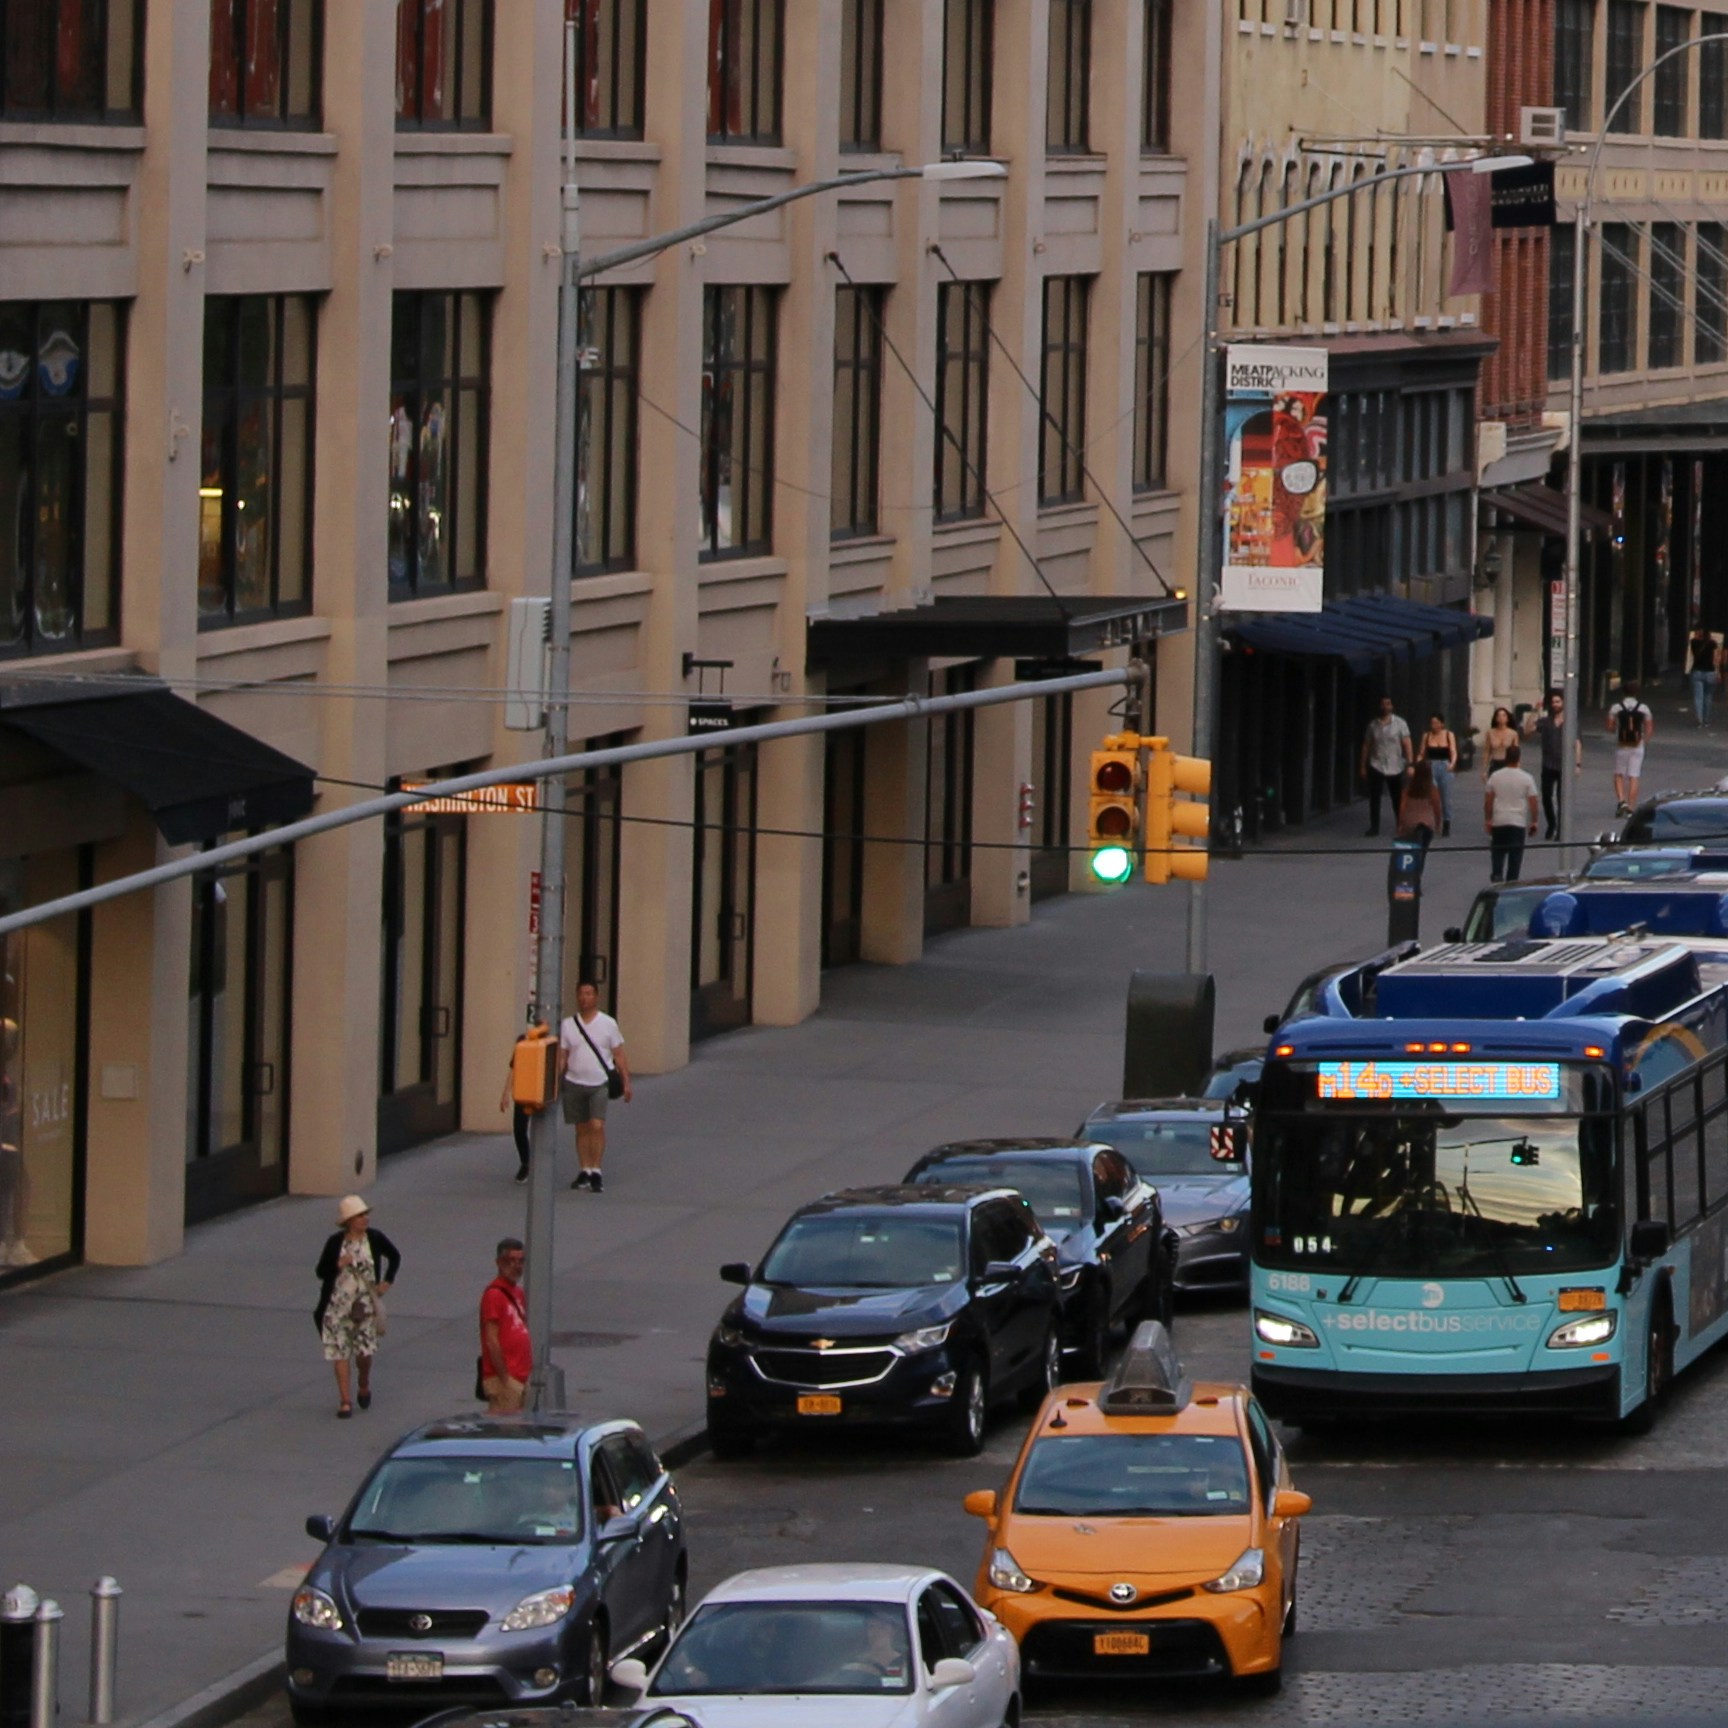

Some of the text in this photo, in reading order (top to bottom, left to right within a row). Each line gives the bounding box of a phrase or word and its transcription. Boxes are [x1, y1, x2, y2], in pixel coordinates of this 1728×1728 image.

[1231, 363, 1325, 378] MEATPACKING
[1231, 375, 1286, 388] DISTRICT
[516, 786, 534, 812] ST
[1505, 1066, 1552, 1095] BUS
[31, 1082, 69, 1128] SALE
